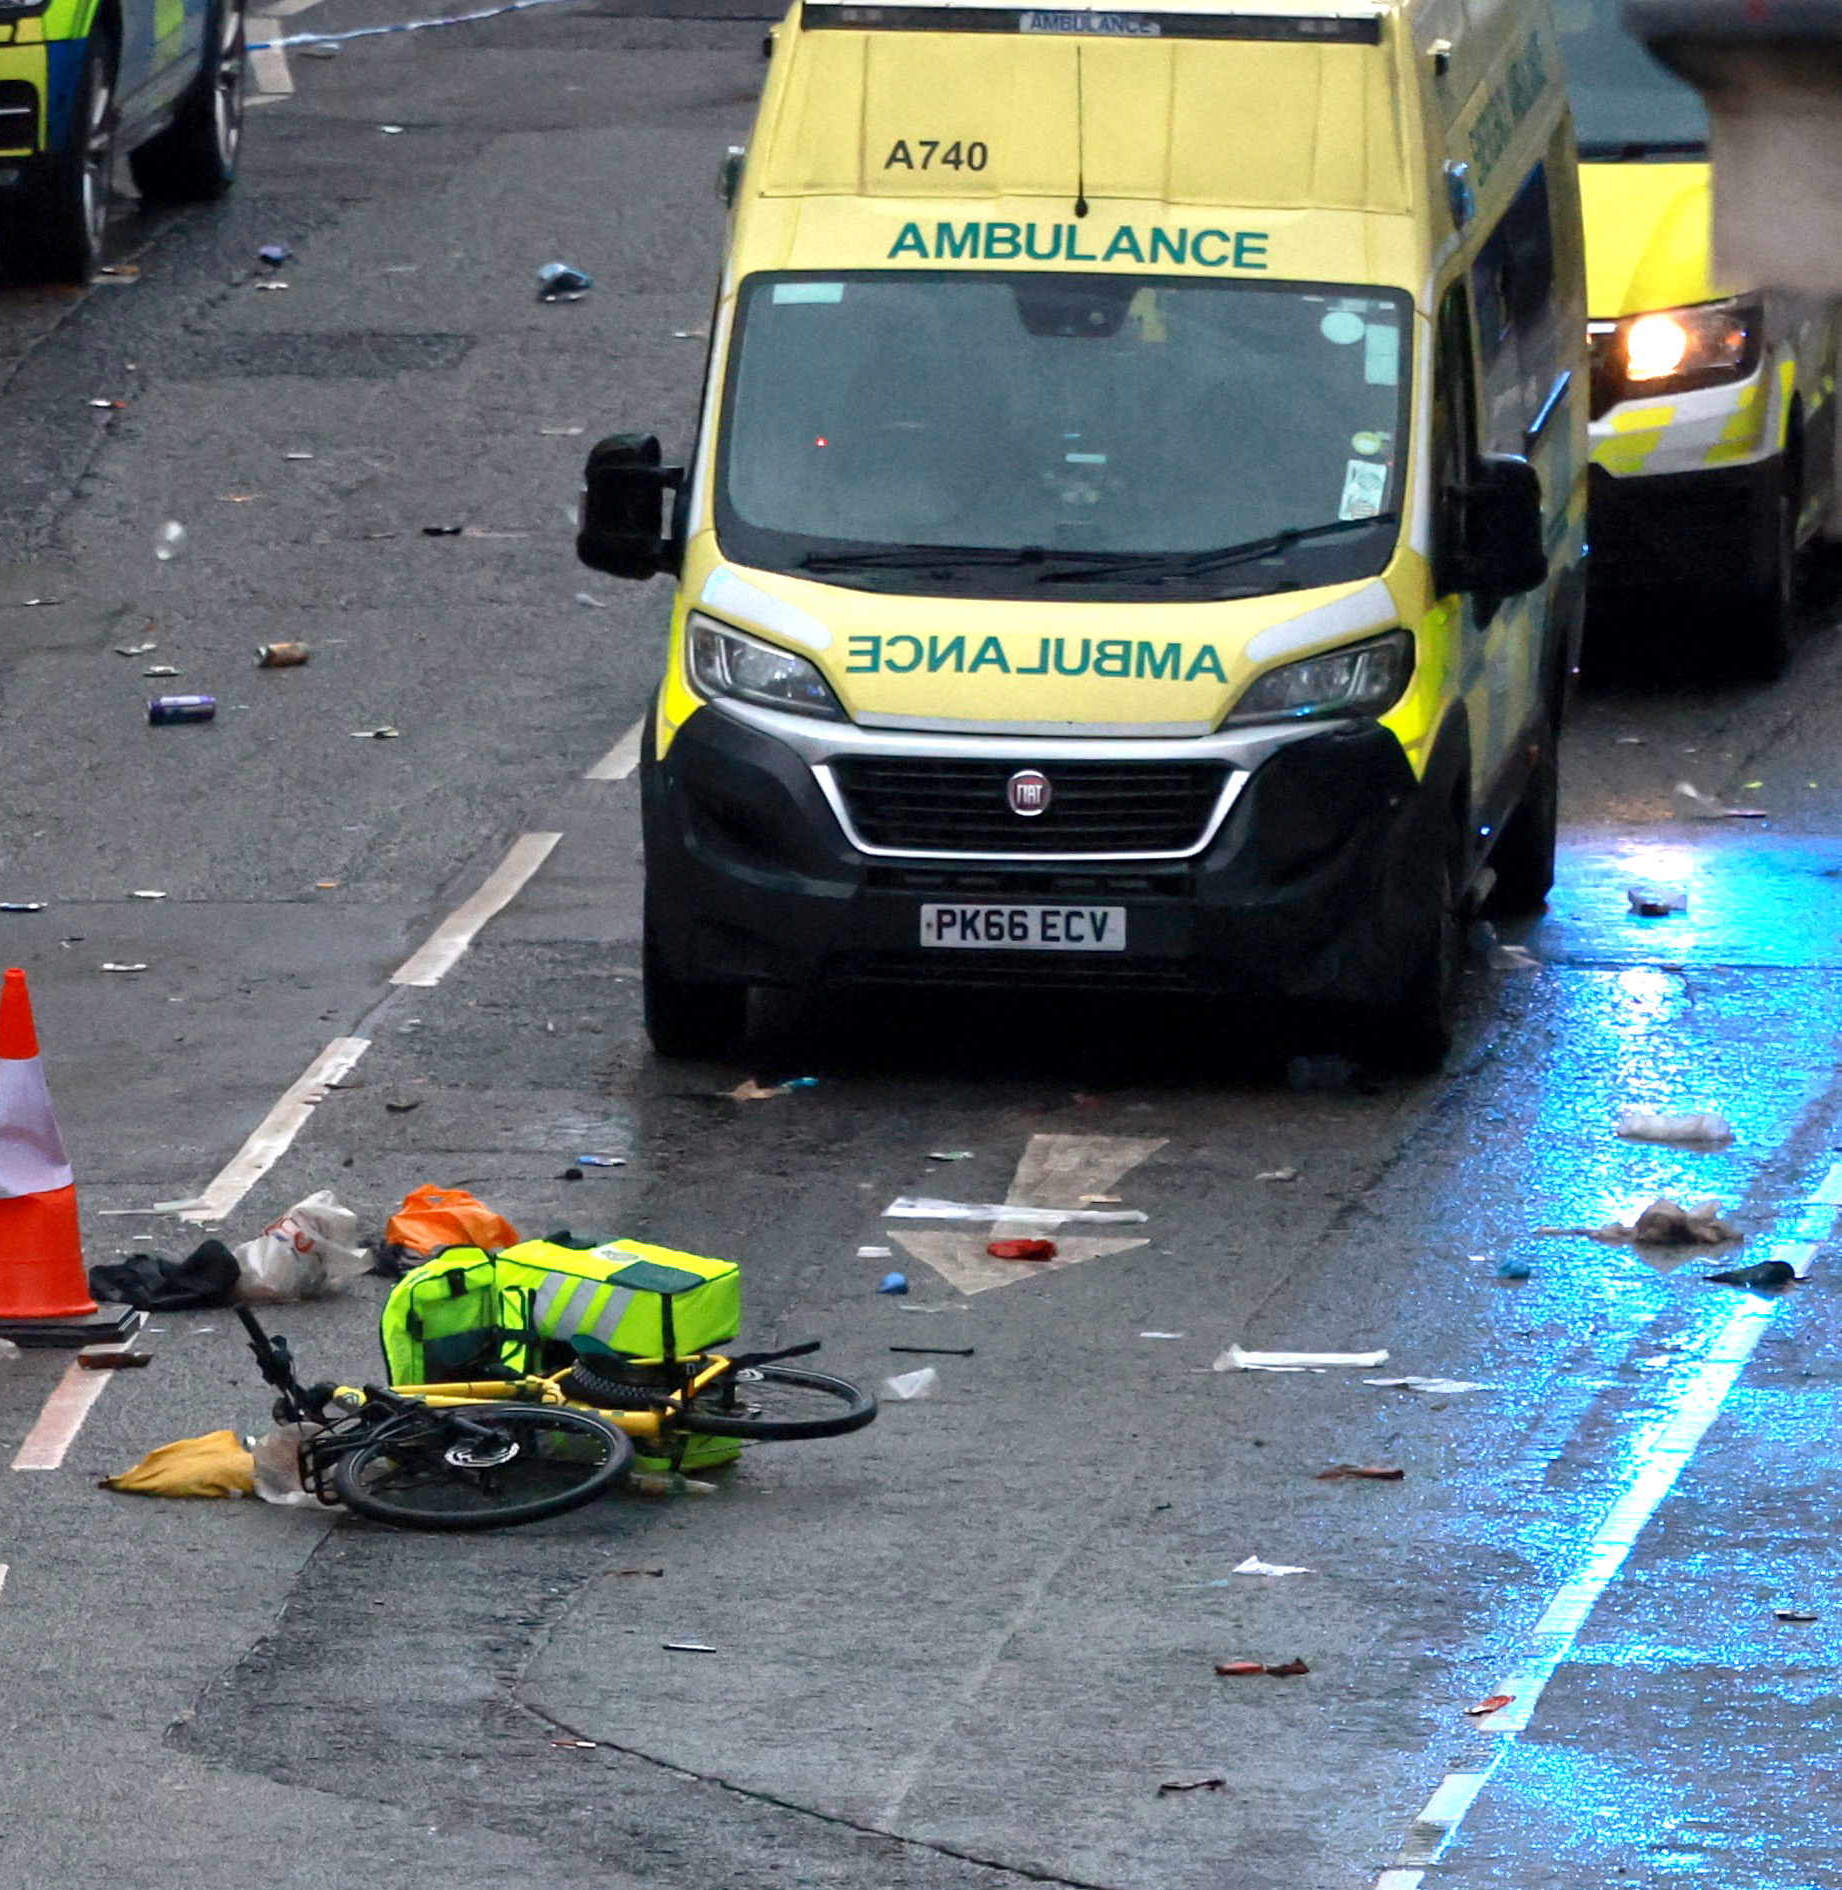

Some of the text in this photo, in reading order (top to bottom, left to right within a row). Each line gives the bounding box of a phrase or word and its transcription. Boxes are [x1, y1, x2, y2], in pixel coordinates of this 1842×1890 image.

[1029, 12, 1152, 33] AMBULANCE
[884, 139, 988, 171] A740
[887, 222, 1269, 270] AMBULANCE
[1016, 784, 1043, 804] FIAT
[935, 908, 1109, 942] PK66 ECV
